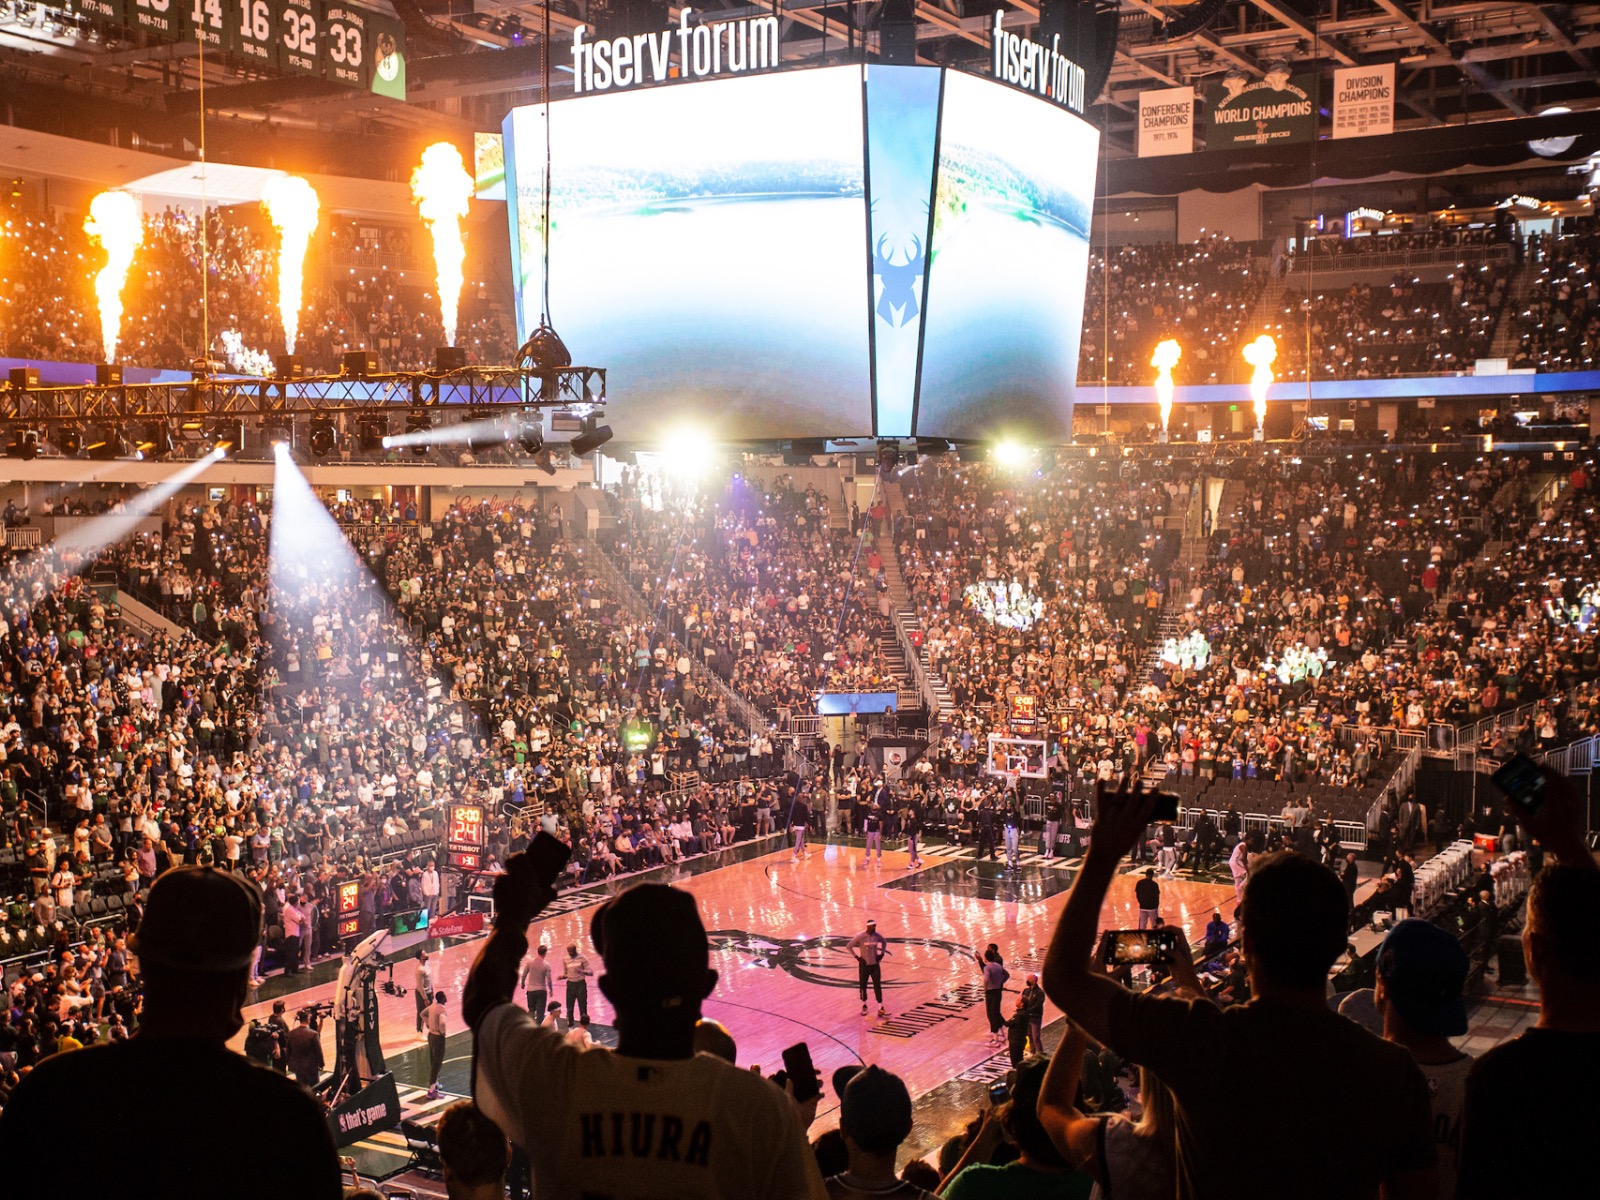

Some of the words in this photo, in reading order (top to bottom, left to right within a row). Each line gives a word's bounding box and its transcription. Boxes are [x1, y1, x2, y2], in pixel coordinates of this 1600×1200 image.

[191, 0, 222, 28] 14
[240, 0, 269, 41] 16
[283, 8, 316, 55] 32
[330, 23, 362, 67] 33
[571, 7, 779, 93] fiserv.forum
[993, 8, 1085, 114] fiserv.forum
[1346, 75, 1383, 90] DIVISION
[1339, 87, 1390, 103] CHAMPIONS
[1142, 102, 1191, 117] CONFERENCE
[1214, 107, 1250, 124] WORLD
[1252, 101, 1312, 120] CHAMPIONS
[1144, 114, 1188, 128] CHAMPIONS
[1015, 705, 1032, 717] 24
[455, 808, 480, 822] 12:00
[454, 821, 477, 841] 24
[458, 845, 480, 853] TISSOT
[342, 896, 355, 910] 24
[368, 1011, 375, 1030] TV
[345, 1108, 367, 1130] that's
[366, 1103, 387, 1126] game
[580, 1111, 712, 1168] HIURA
